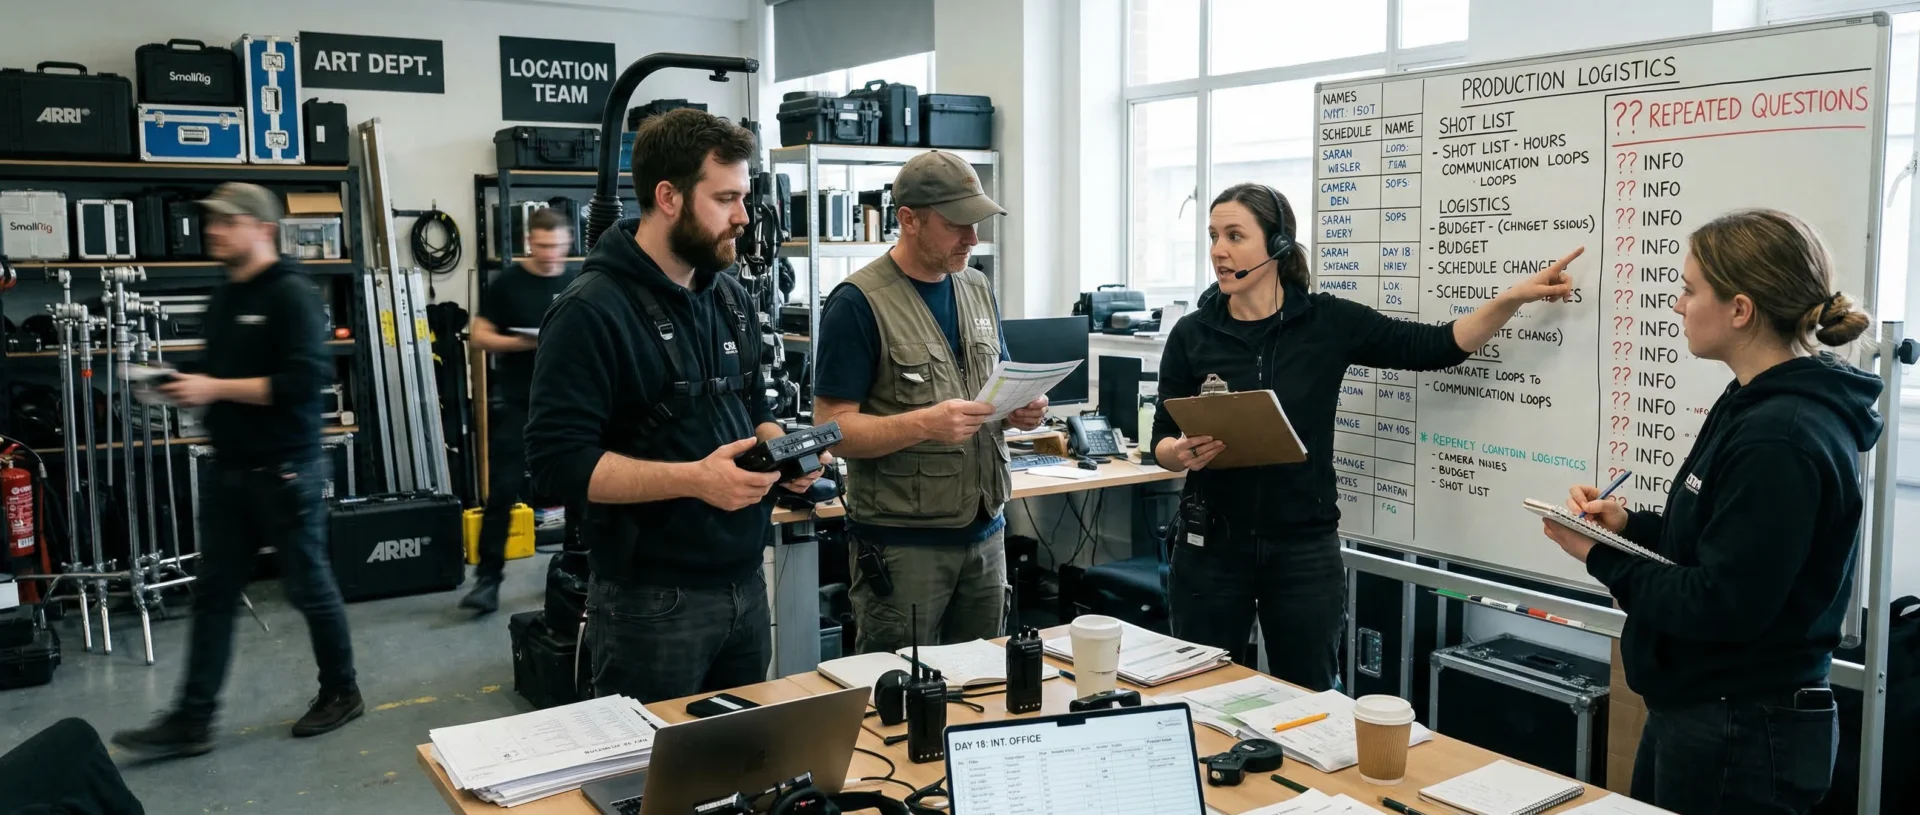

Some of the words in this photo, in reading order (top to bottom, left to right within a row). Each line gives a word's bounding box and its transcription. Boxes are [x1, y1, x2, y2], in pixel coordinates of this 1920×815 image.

[314, 50, 362, 73] ART
[368, 53, 432, 76] DEPT.
[509, 58, 608, 82] LOCATION
[169, 71, 211, 85] SmallRig
[1462, 70, 1565, 101] PRODUCTION
[1578, 56, 1676, 87] LOGISTICS
[532, 82, 588, 104] TEAM
[1323, 91, 1357, 105] NAMES
[1649, 97, 1742, 129] REPEATED
[1751, 86, 1868, 119] QUESTIONS
[1385, 121, 1414, 135] NAME
[1439, 115, 1476, 134] SHOT
[1482, 111, 1515, 130] LIST
[1322, 125, 1372, 140] SCHEDULE
[1442, 143, 1477, 159] SHOT
[1482, 139, 1510, 155] LIST
[1523, 134, 1566, 150] HOURS
[1442, 156, 1539, 176] COMMUNICATION
[1548, 151, 1590, 167] LOOPS
[1643, 152, 1684, 171] INFO
[1321, 182, 1357, 193] CAMERA
[1480, 175, 1517, 187] LOOPS
[1643, 182, 1681, 198] INFO
[1330, 197, 1349, 206] DEN
[1439, 196, 1510, 214] LOGISTICS
[1321, 215, 1352, 225] SARAH
[1385, 212, 1407, 221] SOPS
[1642, 210, 1682, 226] INFO
[10, 222, 53, 233] SmallRig
[1438, 220, 1486, 235] BUDGET
[1321, 248, 1349, 257] SARAH
[1382, 247, 1399, 256] DAY
[1438, 240, 1489, 254] BUDGET
[1641, 239, 1680, 255] INFO
[1437, 260, 1497, 274] SCHEDULE
[1641, 267, 1679, 283] INFO
[1436, 284, 1499, 299] SCHEDULE
[1640, 293, 1678, 309] INFO
[1640, 321, 1680, 338] INFO
[1640, 347, 1678, 364] INFO
[1495, 370, 1526, 383] LOOPS
[1638, 372, 1676, 389] INFO
[1379, 389, 1394, 398] DAY
[1433, 381, 1515, 402] COMMUNICATION
[1520, 393, 1552, 409] LOOPS
[1637, 397, 1676, 416] INFO
[1378, 422, 1394, 432] DAY
[1637, 422, 1675, 441] INFO
[1438, 452, 1474, 466] CAMERA
[1635, 447, 1674, 467] INFO
[1439, 465, 1476, 480] BUDGET
[1439, 479, 1464, 492] SHOT
[1468, 484, 1490, 497] LIST
[954, 741, 973, 752] DAY
[975, 739, 989, 750] 18:
[990, 737, 1008, 748] INT.
[1009, 733, 1042, 746] OFFICE
